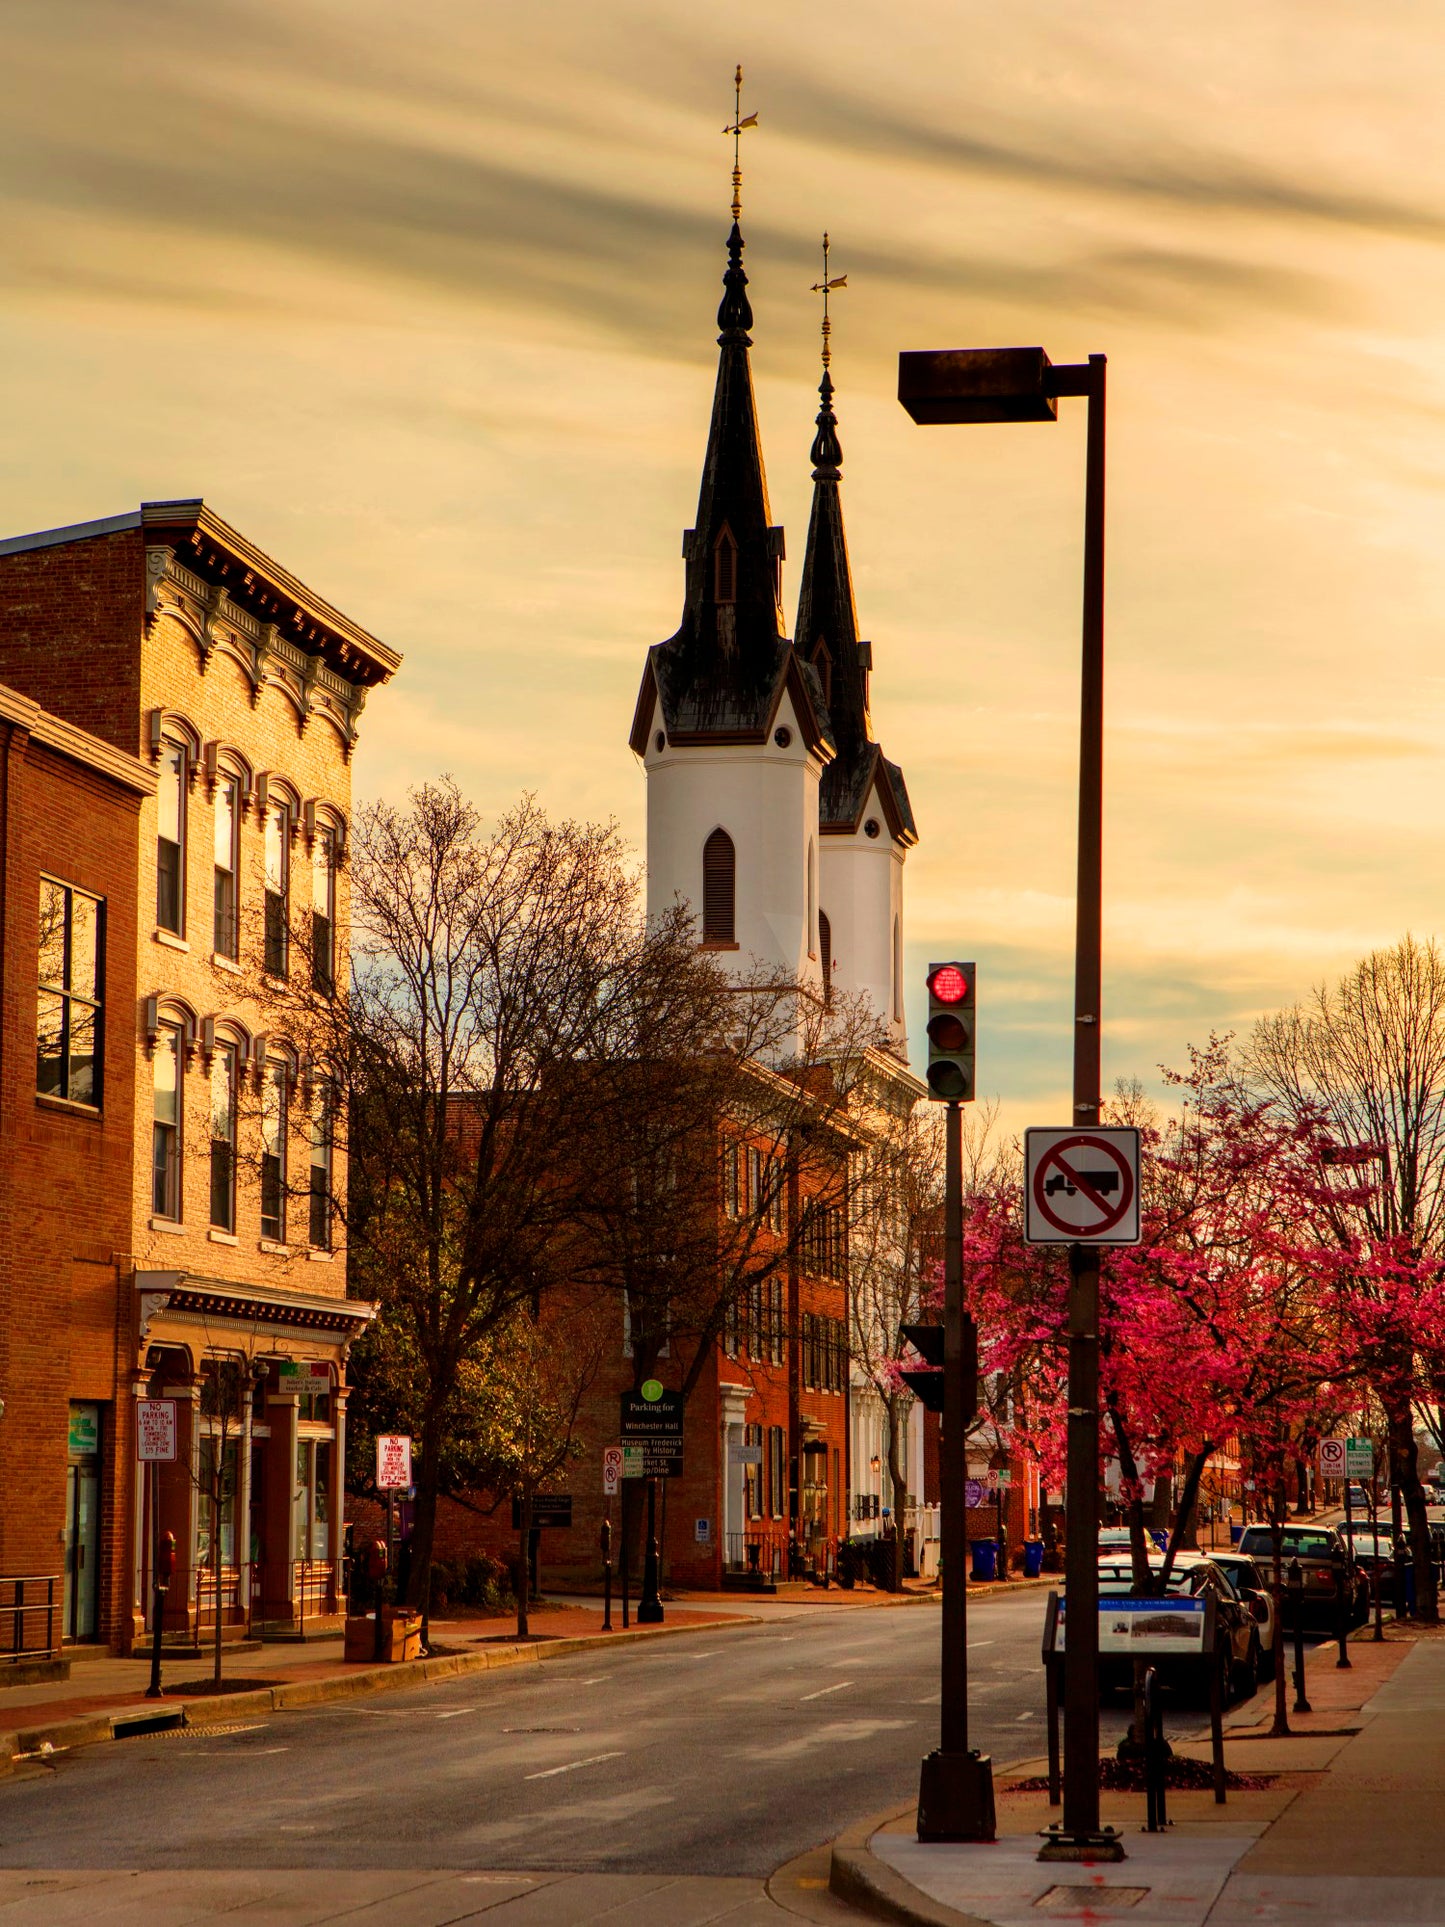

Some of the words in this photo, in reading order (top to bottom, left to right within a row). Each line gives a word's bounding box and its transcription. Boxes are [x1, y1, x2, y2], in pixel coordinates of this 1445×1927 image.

[648, 1384, 658, 1396] P
[149, 1403, 161, 1411] NO
[630, 1402, 662, 1413] Parking
[662, 1402, 675, 1411] for
[142, 1411, 169, 1419] PARKING
[625, 1422, 663, 1430] Winchester
[665, 1422, 679, 1430] Hall
[621, 1439, 649, 1447] Museum
[651, 1439, 682, 1447] Frederick
[156, 1446, 169, 1454] FINE
[652, 1447, 677, 1456] History
[643, 1467, 670, 1475] op/Dine
